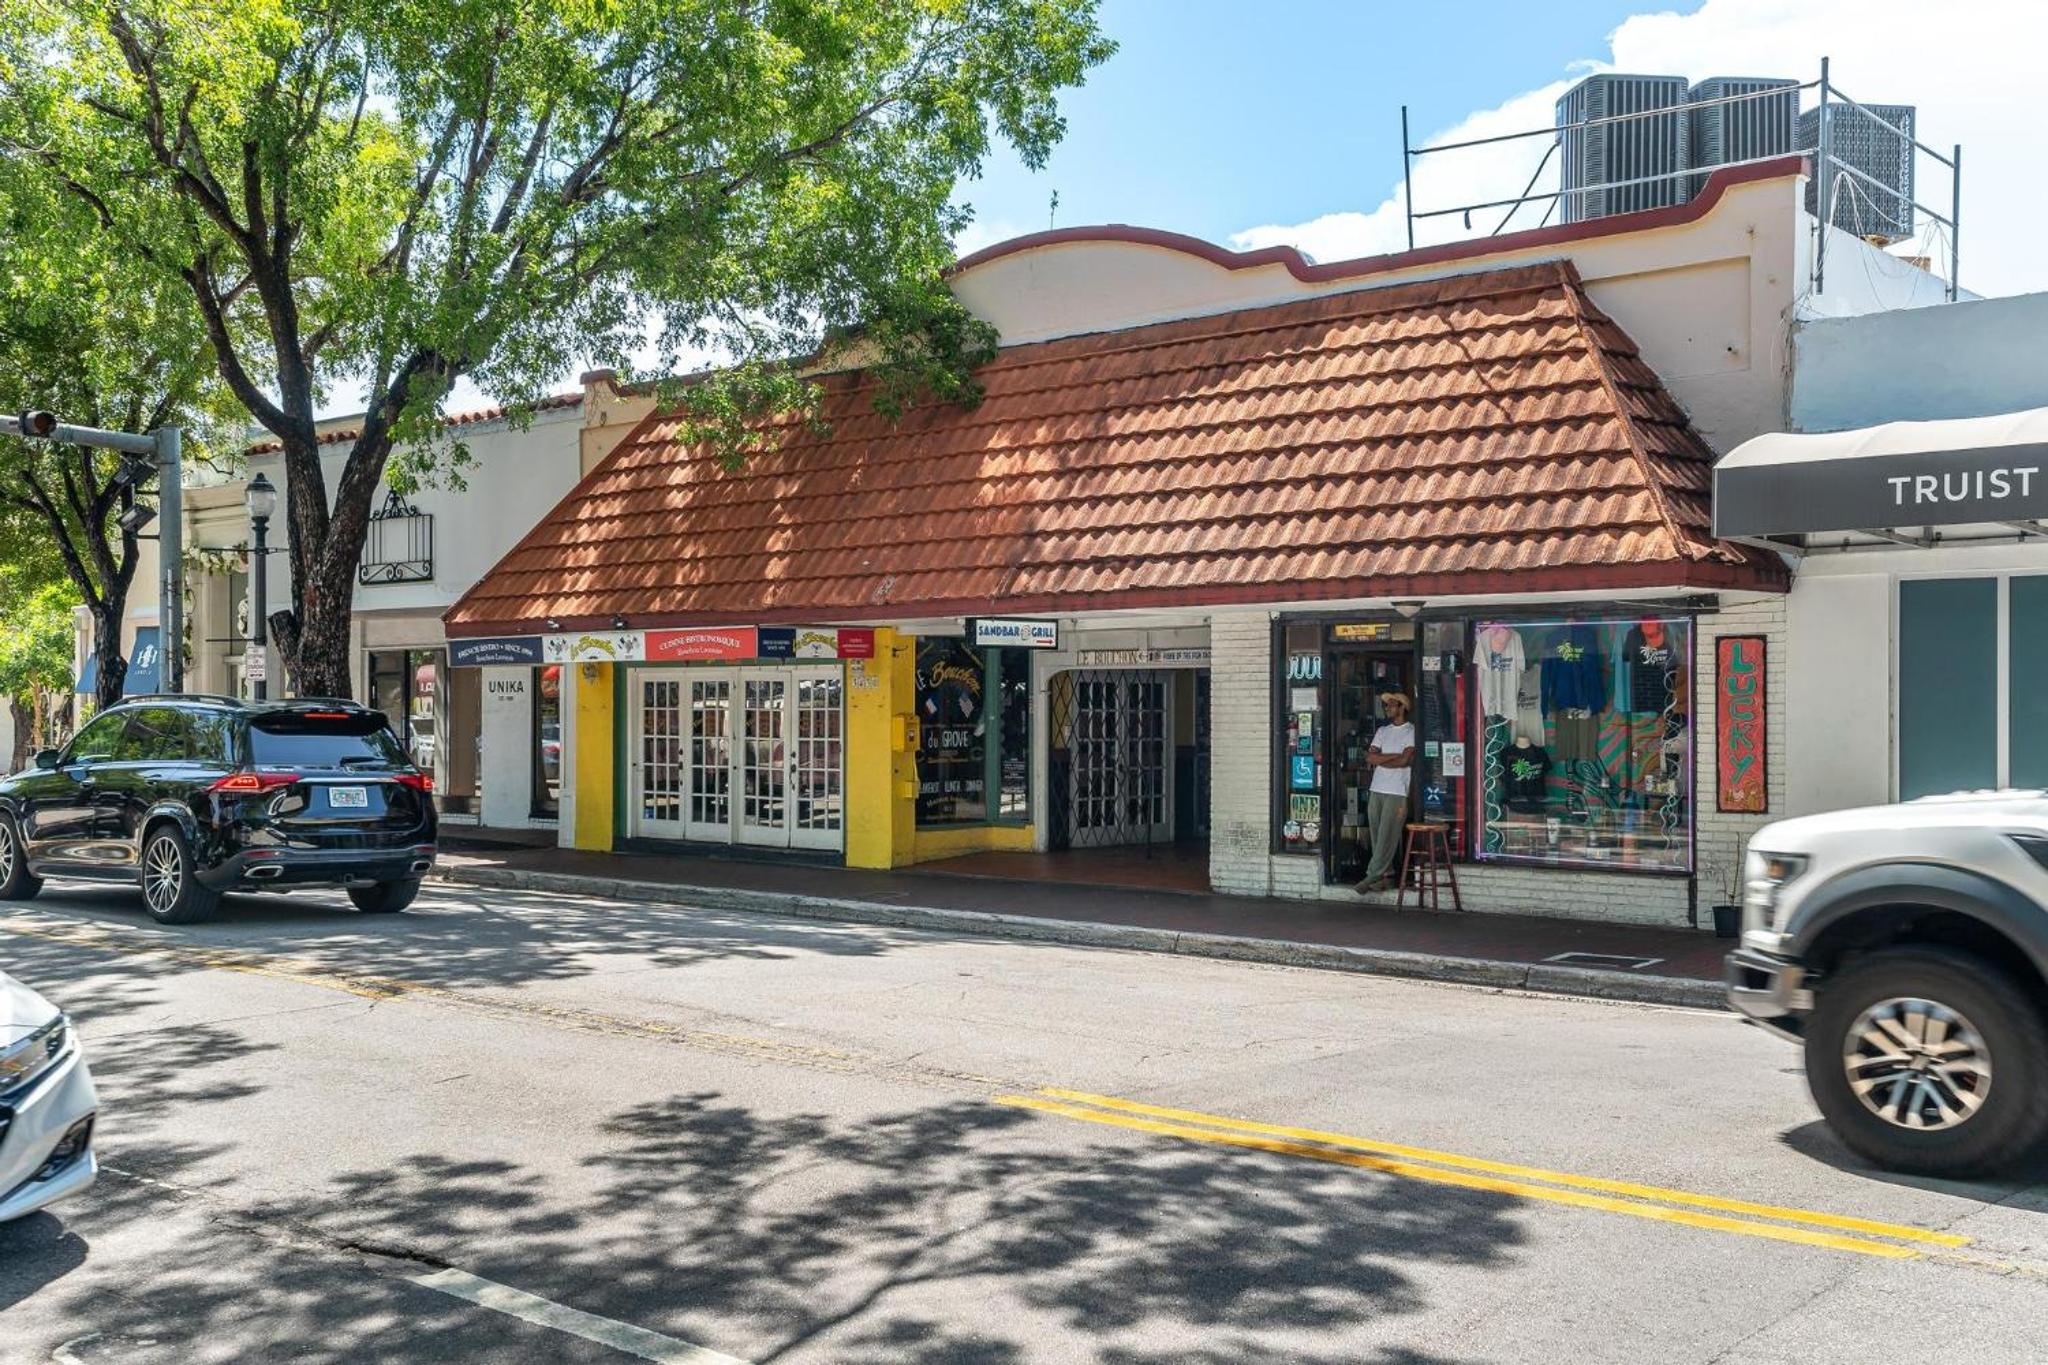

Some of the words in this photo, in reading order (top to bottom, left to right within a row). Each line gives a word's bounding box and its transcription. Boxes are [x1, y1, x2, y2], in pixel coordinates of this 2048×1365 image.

[1887, 467, 2039, 505] TRUIST
[978, 626, 1020, 637] SANDBAR
[1031, 627, 1054, 637] GRILL
[489, 680, 524, 693] UNIKA
[930, 660, 981, 697] Bouchon
[1727, 641, 1757, 784] LUCKY
[928, 731, 939, 748] du
[942, 731, 968, 748] GROVE
